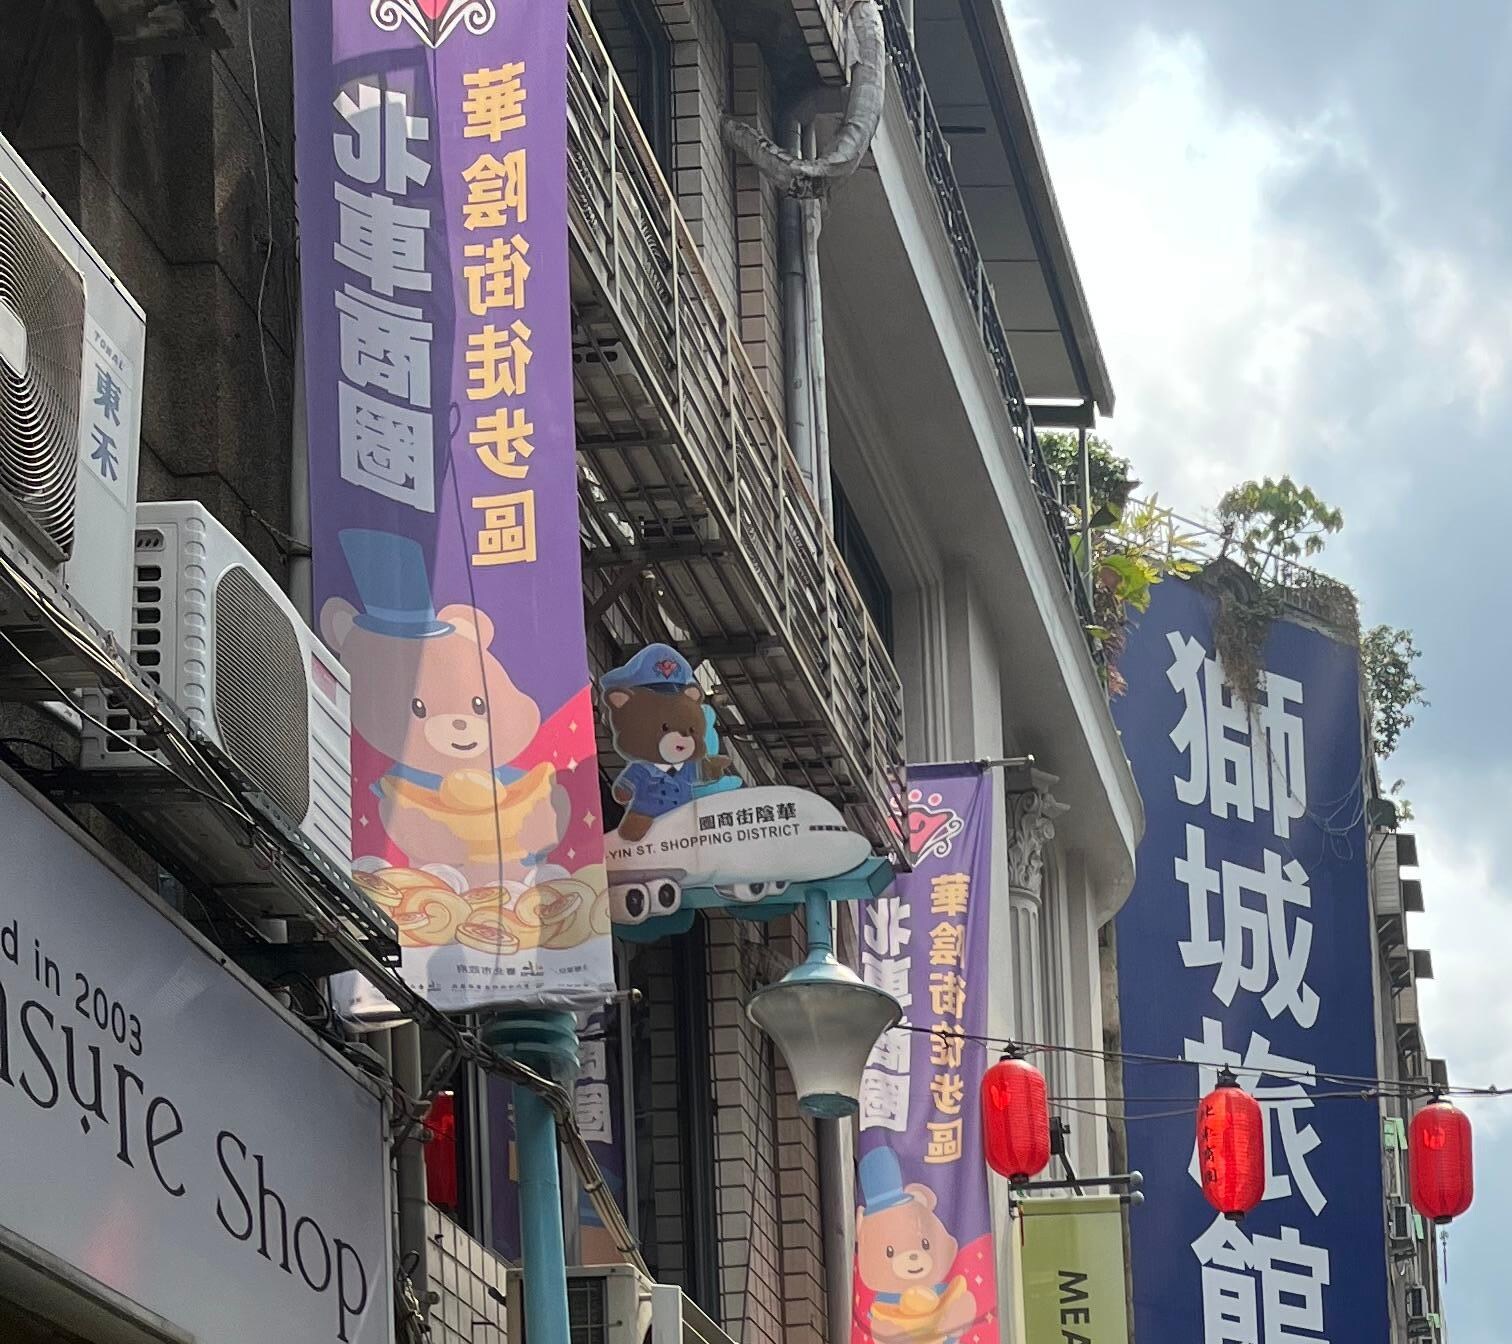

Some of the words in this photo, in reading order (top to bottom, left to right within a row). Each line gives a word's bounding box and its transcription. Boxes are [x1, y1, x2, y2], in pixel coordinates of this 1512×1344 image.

[91, 363, 122, 482] 東禾
[636, 844, 656, 856] ST.
[661, 830, 733, 852] SHOPPING
[738, 823, 801, 842] DISTRICT
[34, 938, 61, 997] in
[75, 972, 144, 1057] 2003
[216, 1130, 368, 1344] Shop
